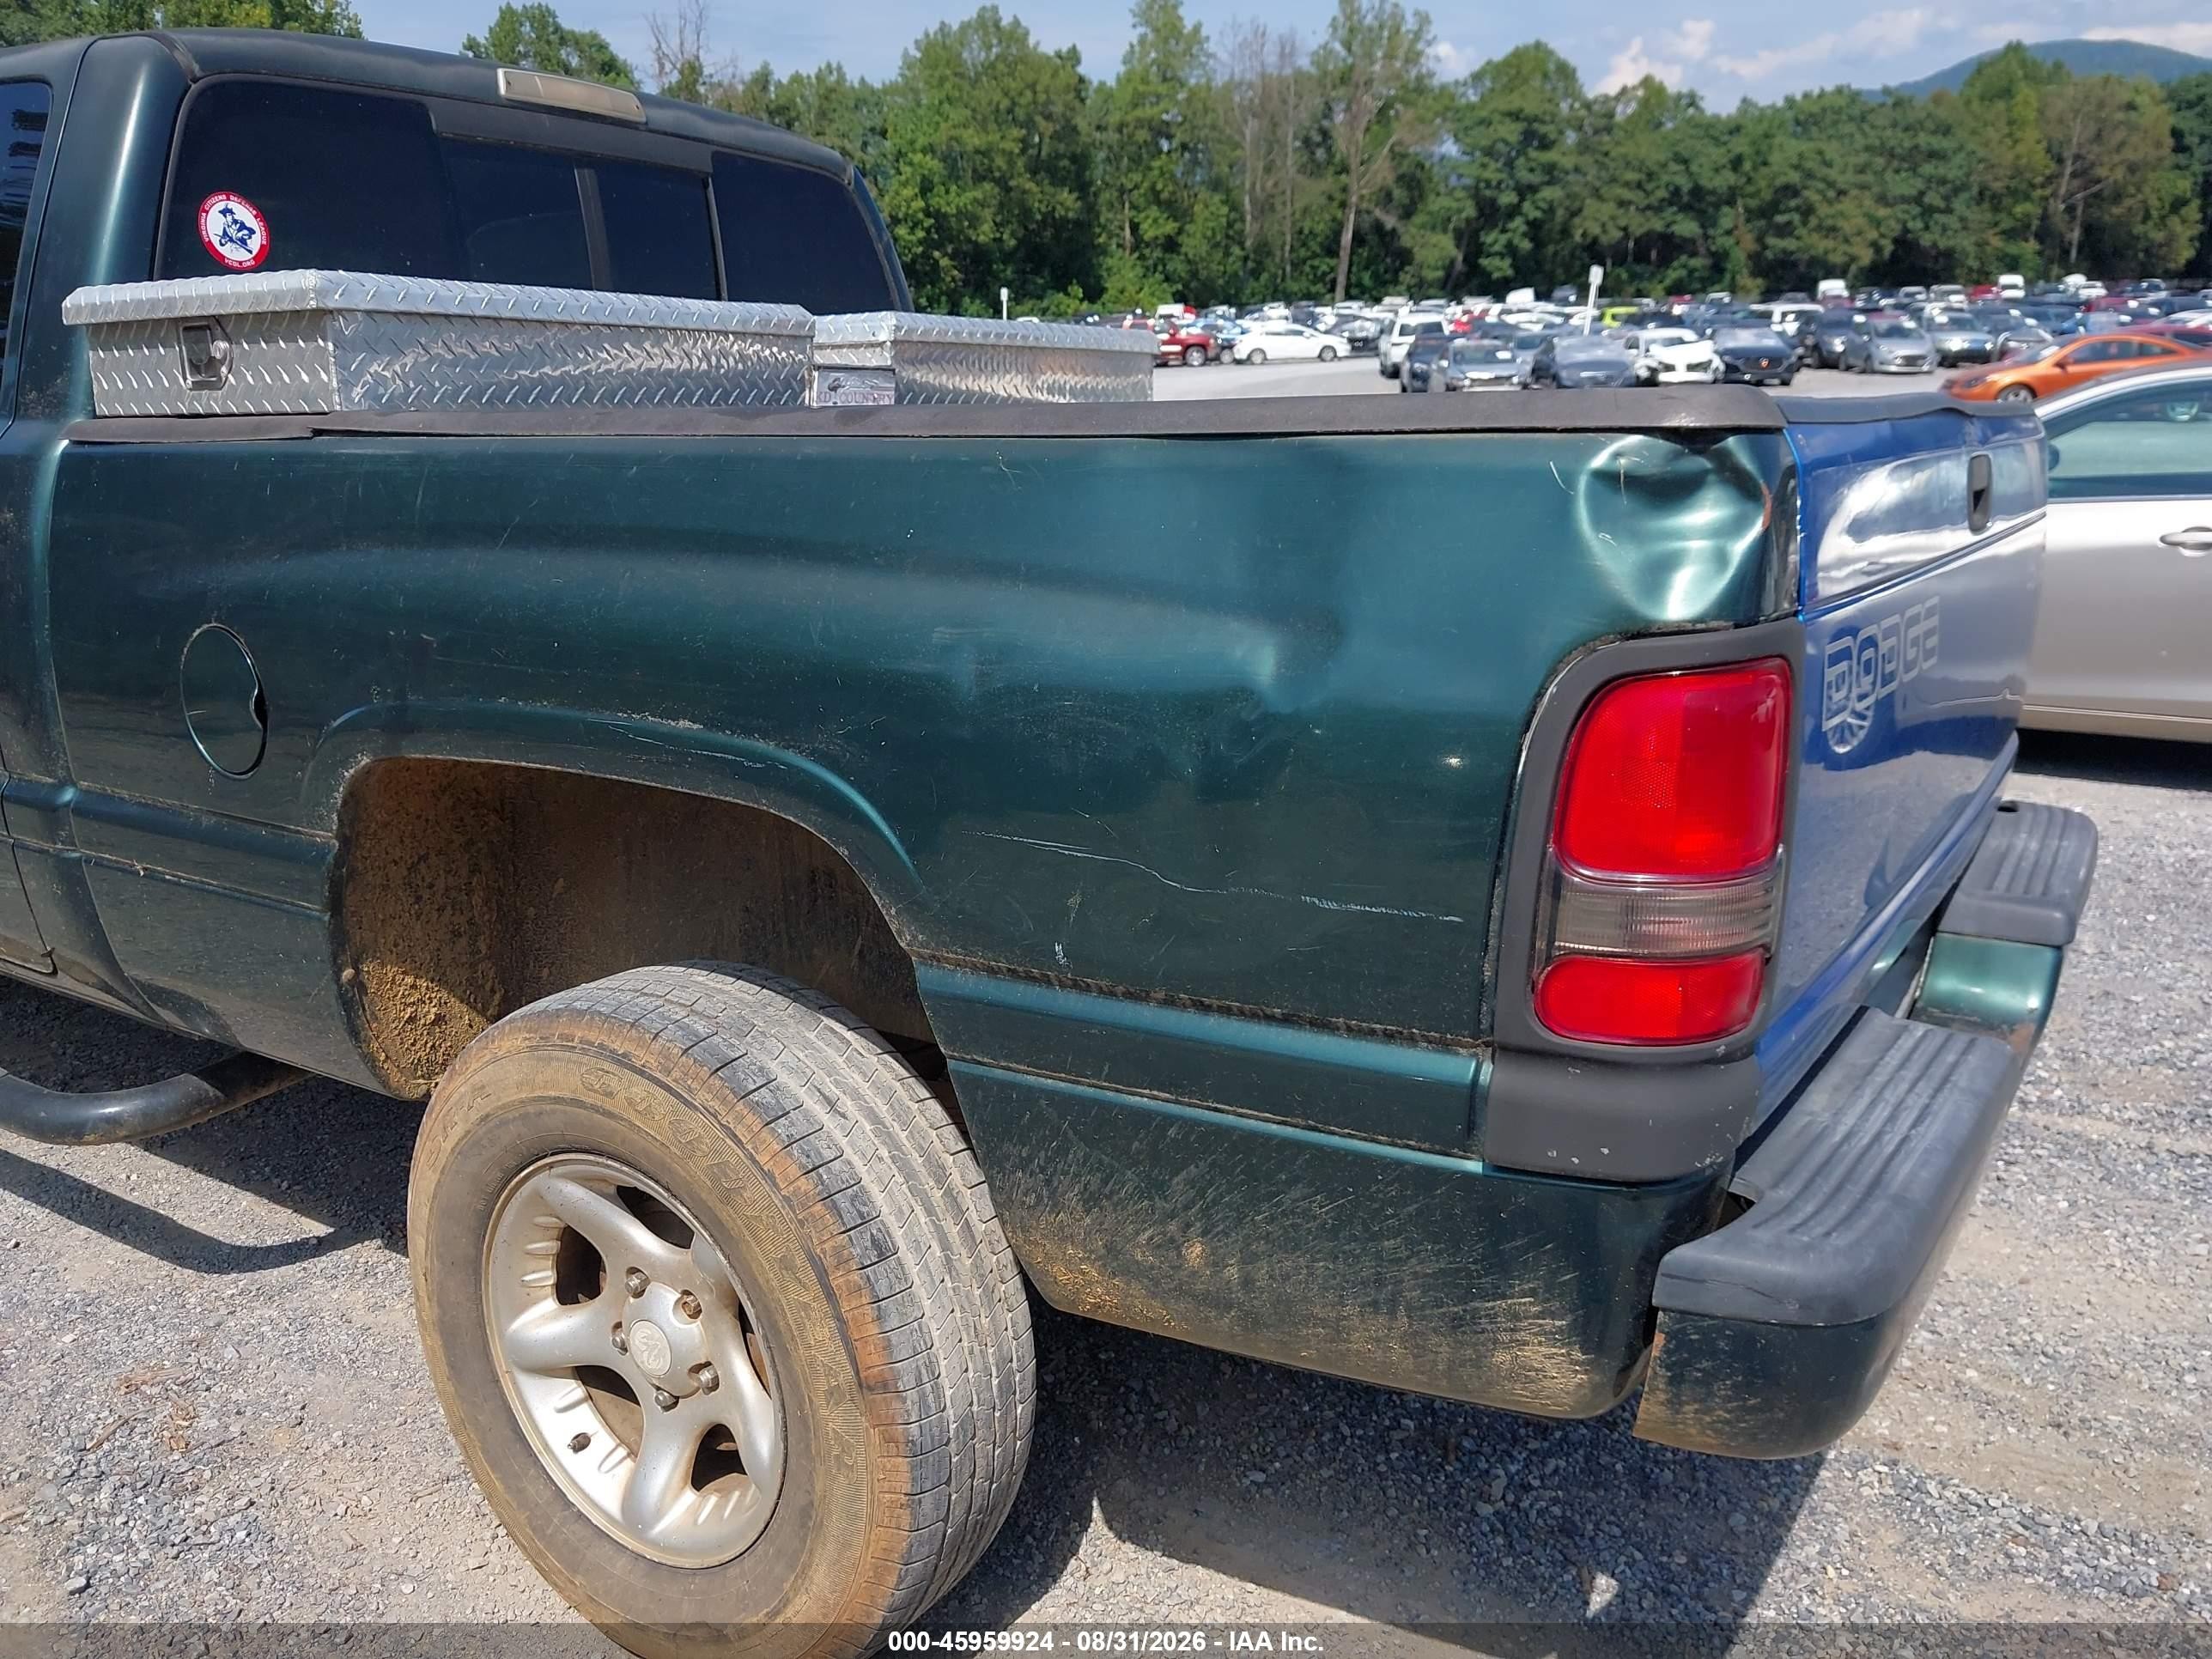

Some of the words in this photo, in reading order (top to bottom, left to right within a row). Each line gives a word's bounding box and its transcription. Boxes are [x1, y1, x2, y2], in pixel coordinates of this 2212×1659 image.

[204, 194, 227, 210] CITIZENS
[229, 195, 258, 216] DEFENSE
[200, 212, 210, 242] VIRGINIA
[256, 217, 267, 245] LEAGUE
[224, 257, 256, 268] VCDL.ORG
[1821, 595, 1941, 732] DODGE
[580, 1066, 858, 1485] GOODYEAR
